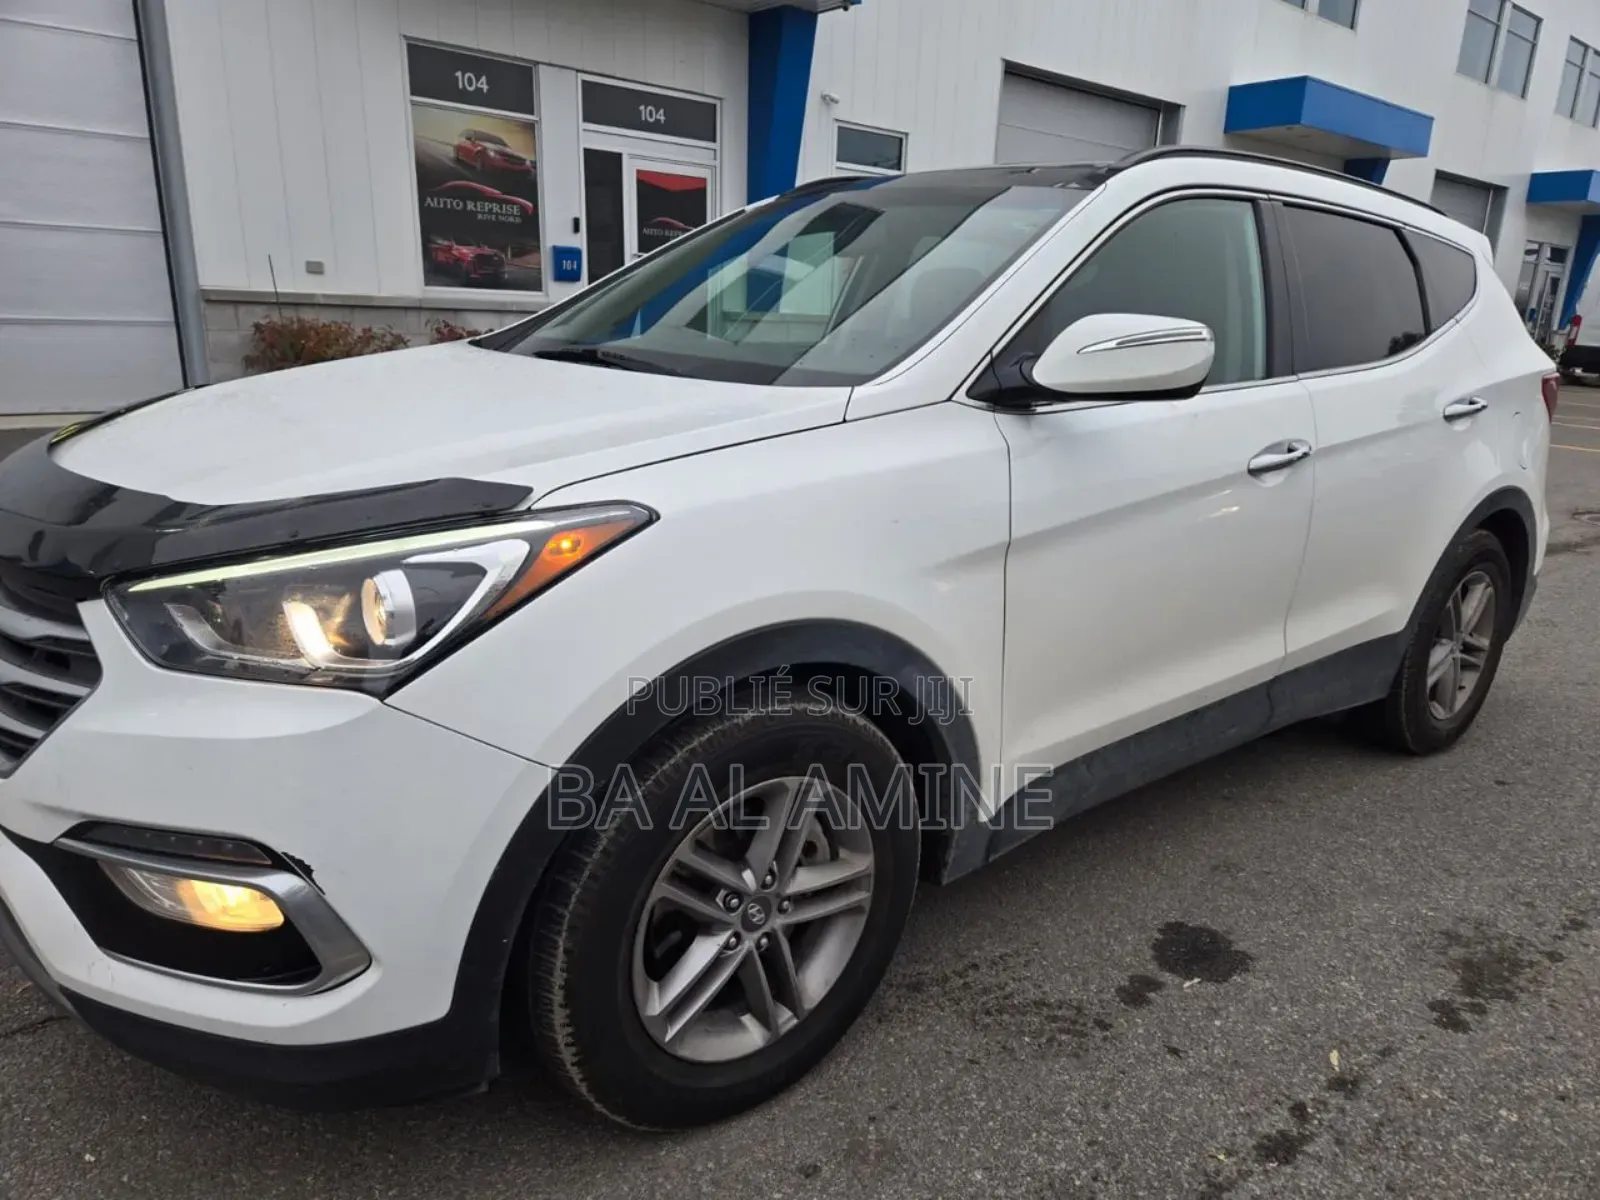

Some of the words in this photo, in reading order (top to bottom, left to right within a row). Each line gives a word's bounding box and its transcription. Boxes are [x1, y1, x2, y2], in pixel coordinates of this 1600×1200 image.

[455, 70, 489, 94] 104
[639, 104, 666, 125] 104
[424, 196, 464, 210] AUTO
[466, 200, 520, 215] REPRISE
[563, 259, 577, 271] 104
